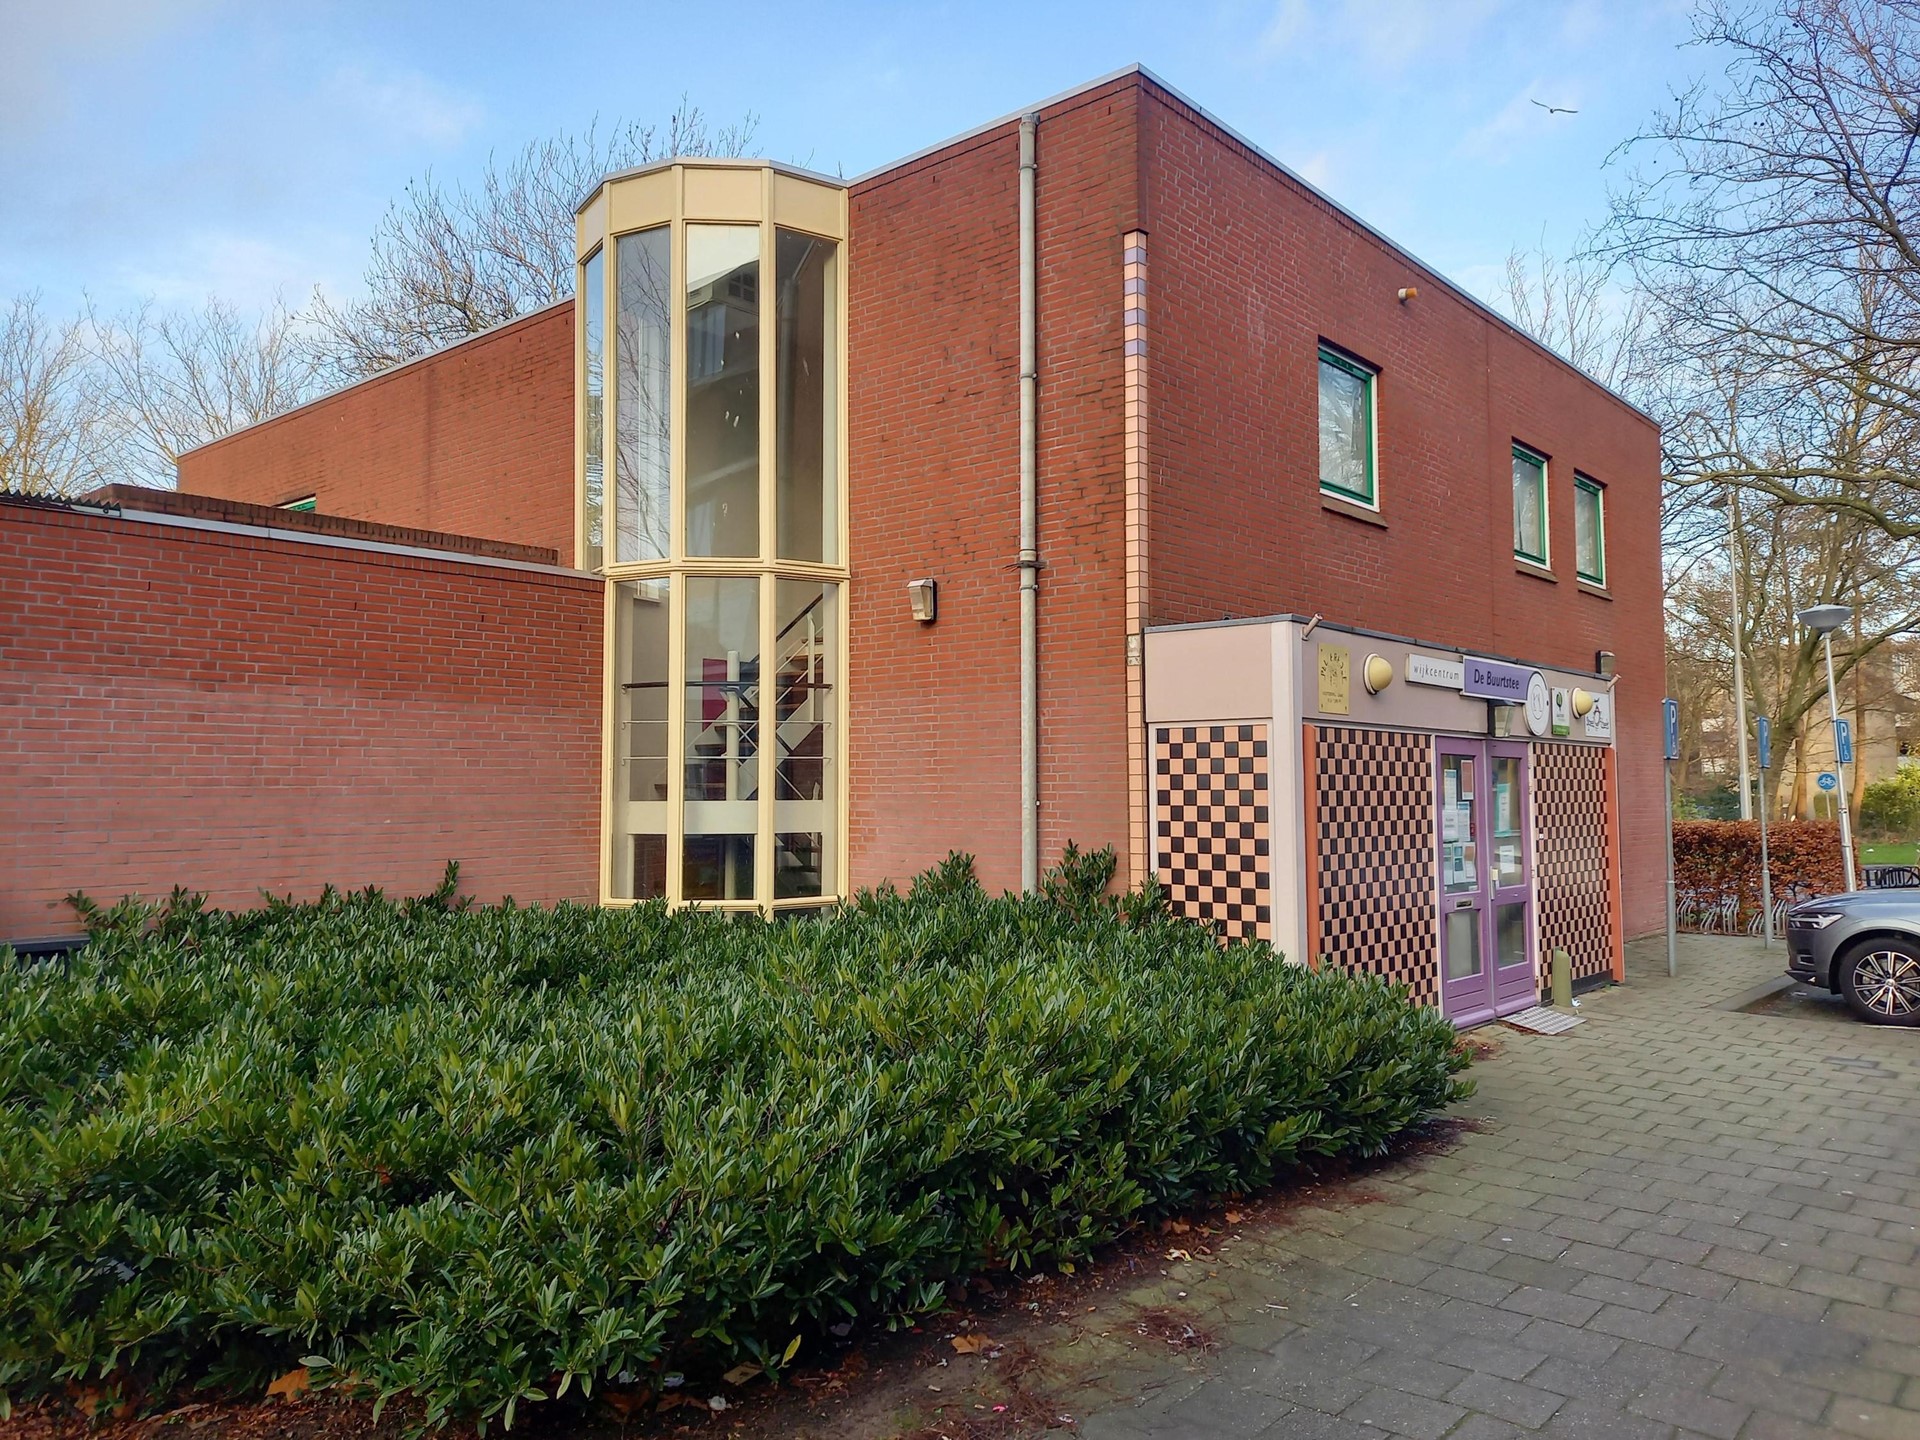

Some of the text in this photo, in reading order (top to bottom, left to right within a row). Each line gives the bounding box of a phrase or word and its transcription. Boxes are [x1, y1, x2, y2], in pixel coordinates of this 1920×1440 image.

[1413, 665, 1459, 680] wijkcentrum
[1474, 668, 1519, 689] De Buurtstee
[1670, 705, 1676, 733] P
[1763, 721, 1768, 745] P
[1841, 723, 1847, 744] P
